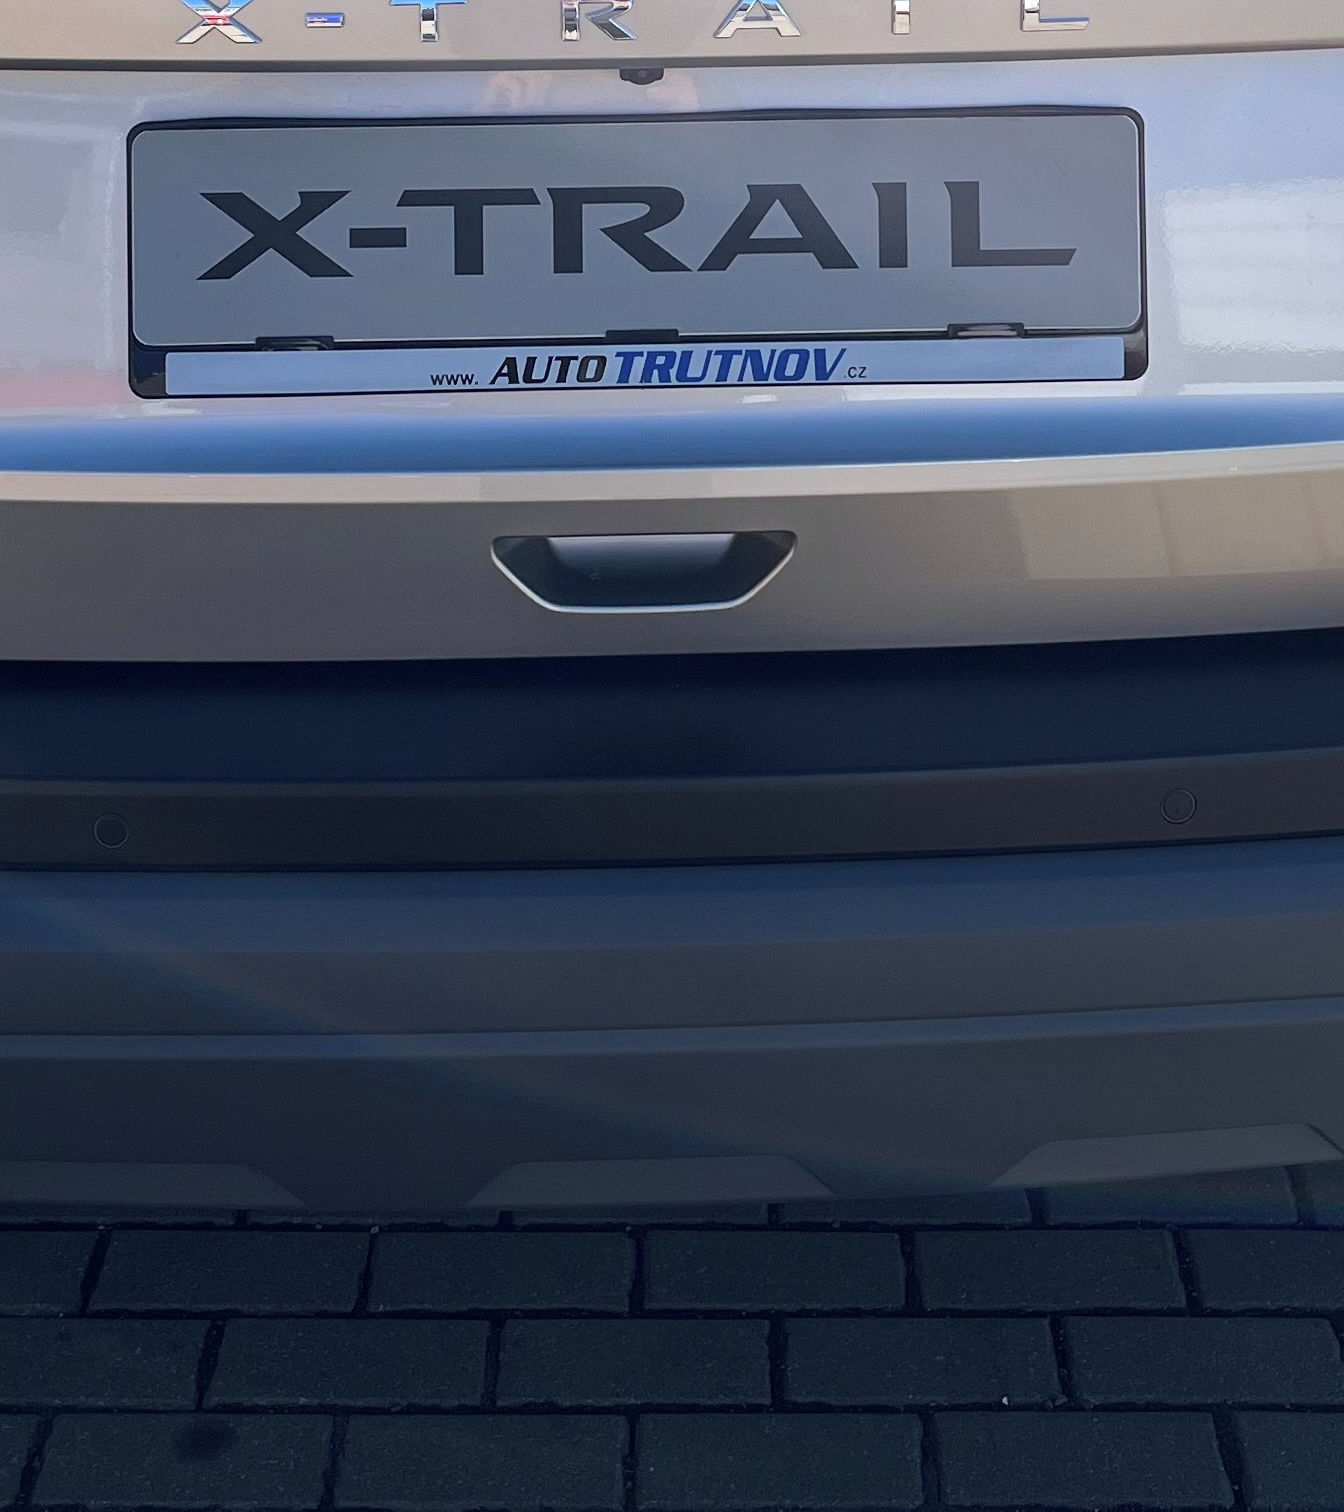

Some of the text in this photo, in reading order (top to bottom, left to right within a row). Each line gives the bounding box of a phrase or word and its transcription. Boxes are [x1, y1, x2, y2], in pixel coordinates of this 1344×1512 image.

[196, 181, 1077, 280] X-TRAIL
[489, 355, 607, 384] AUTO
[613, 348, 847, 382] TRUTNOV
